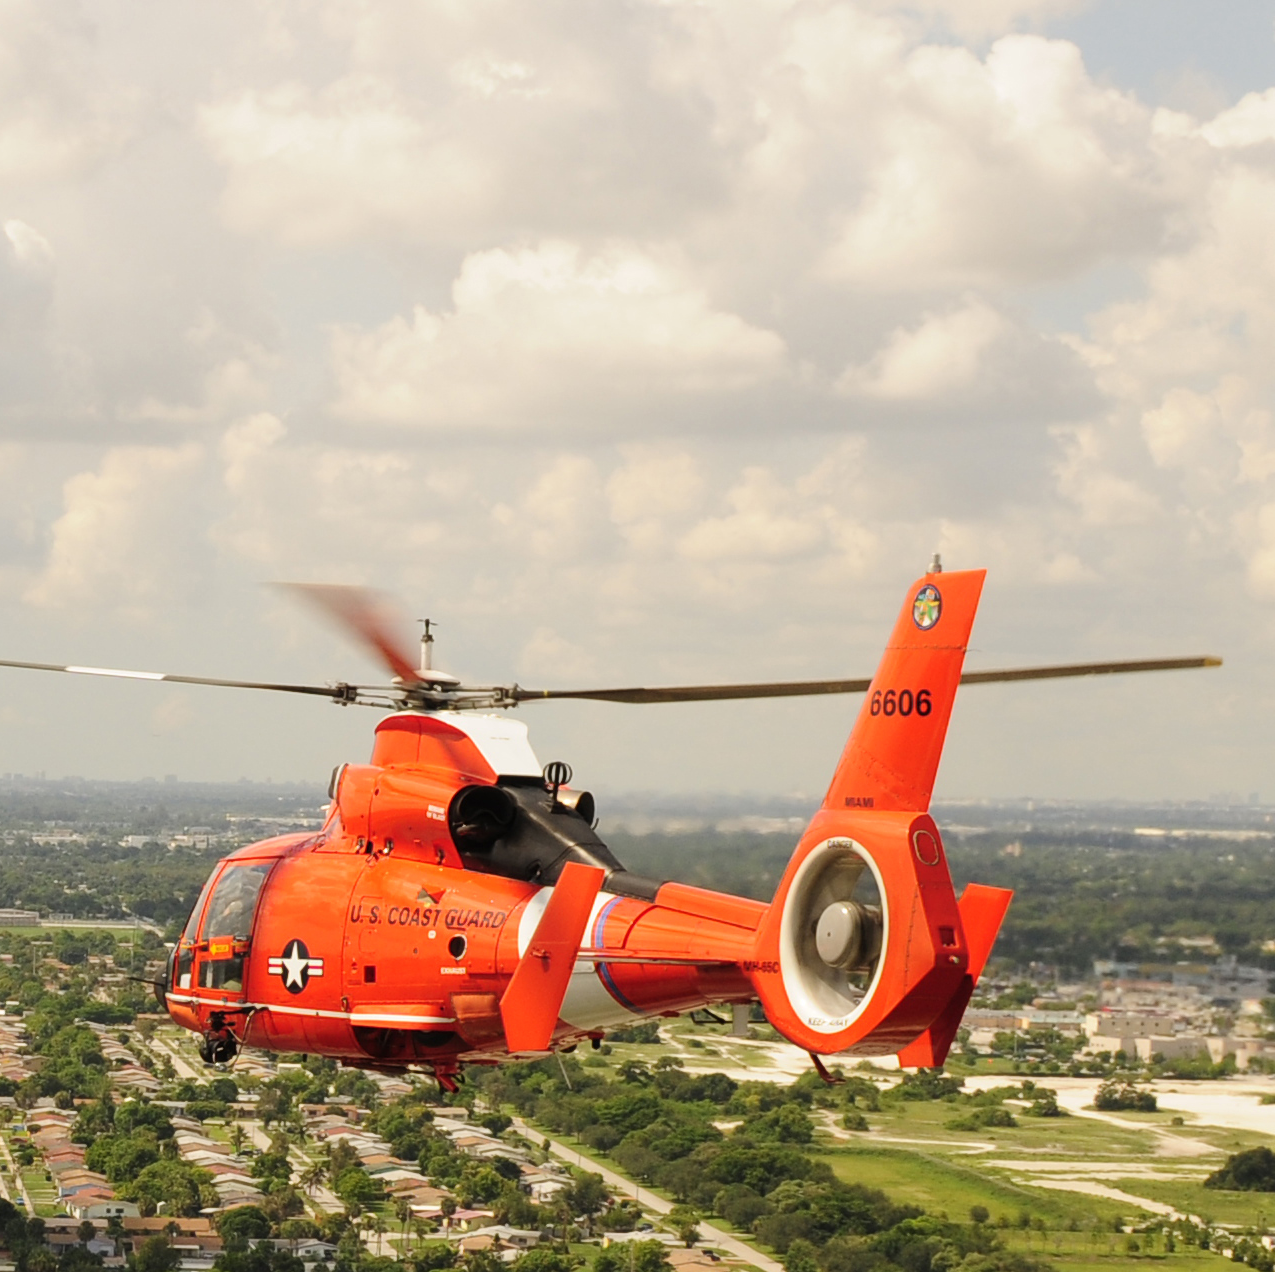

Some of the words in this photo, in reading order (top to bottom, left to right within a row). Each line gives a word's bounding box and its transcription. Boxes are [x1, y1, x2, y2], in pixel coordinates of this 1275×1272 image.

[870, 689, 932, 716] 6606
[844, 797, 874, 808] MIAMI
[351, 905, 363, 923] U.
[369, 906, 382, 924] S.
[388, 907, 442, 927] COAST
[445, 909, 506, 928] GUARD
